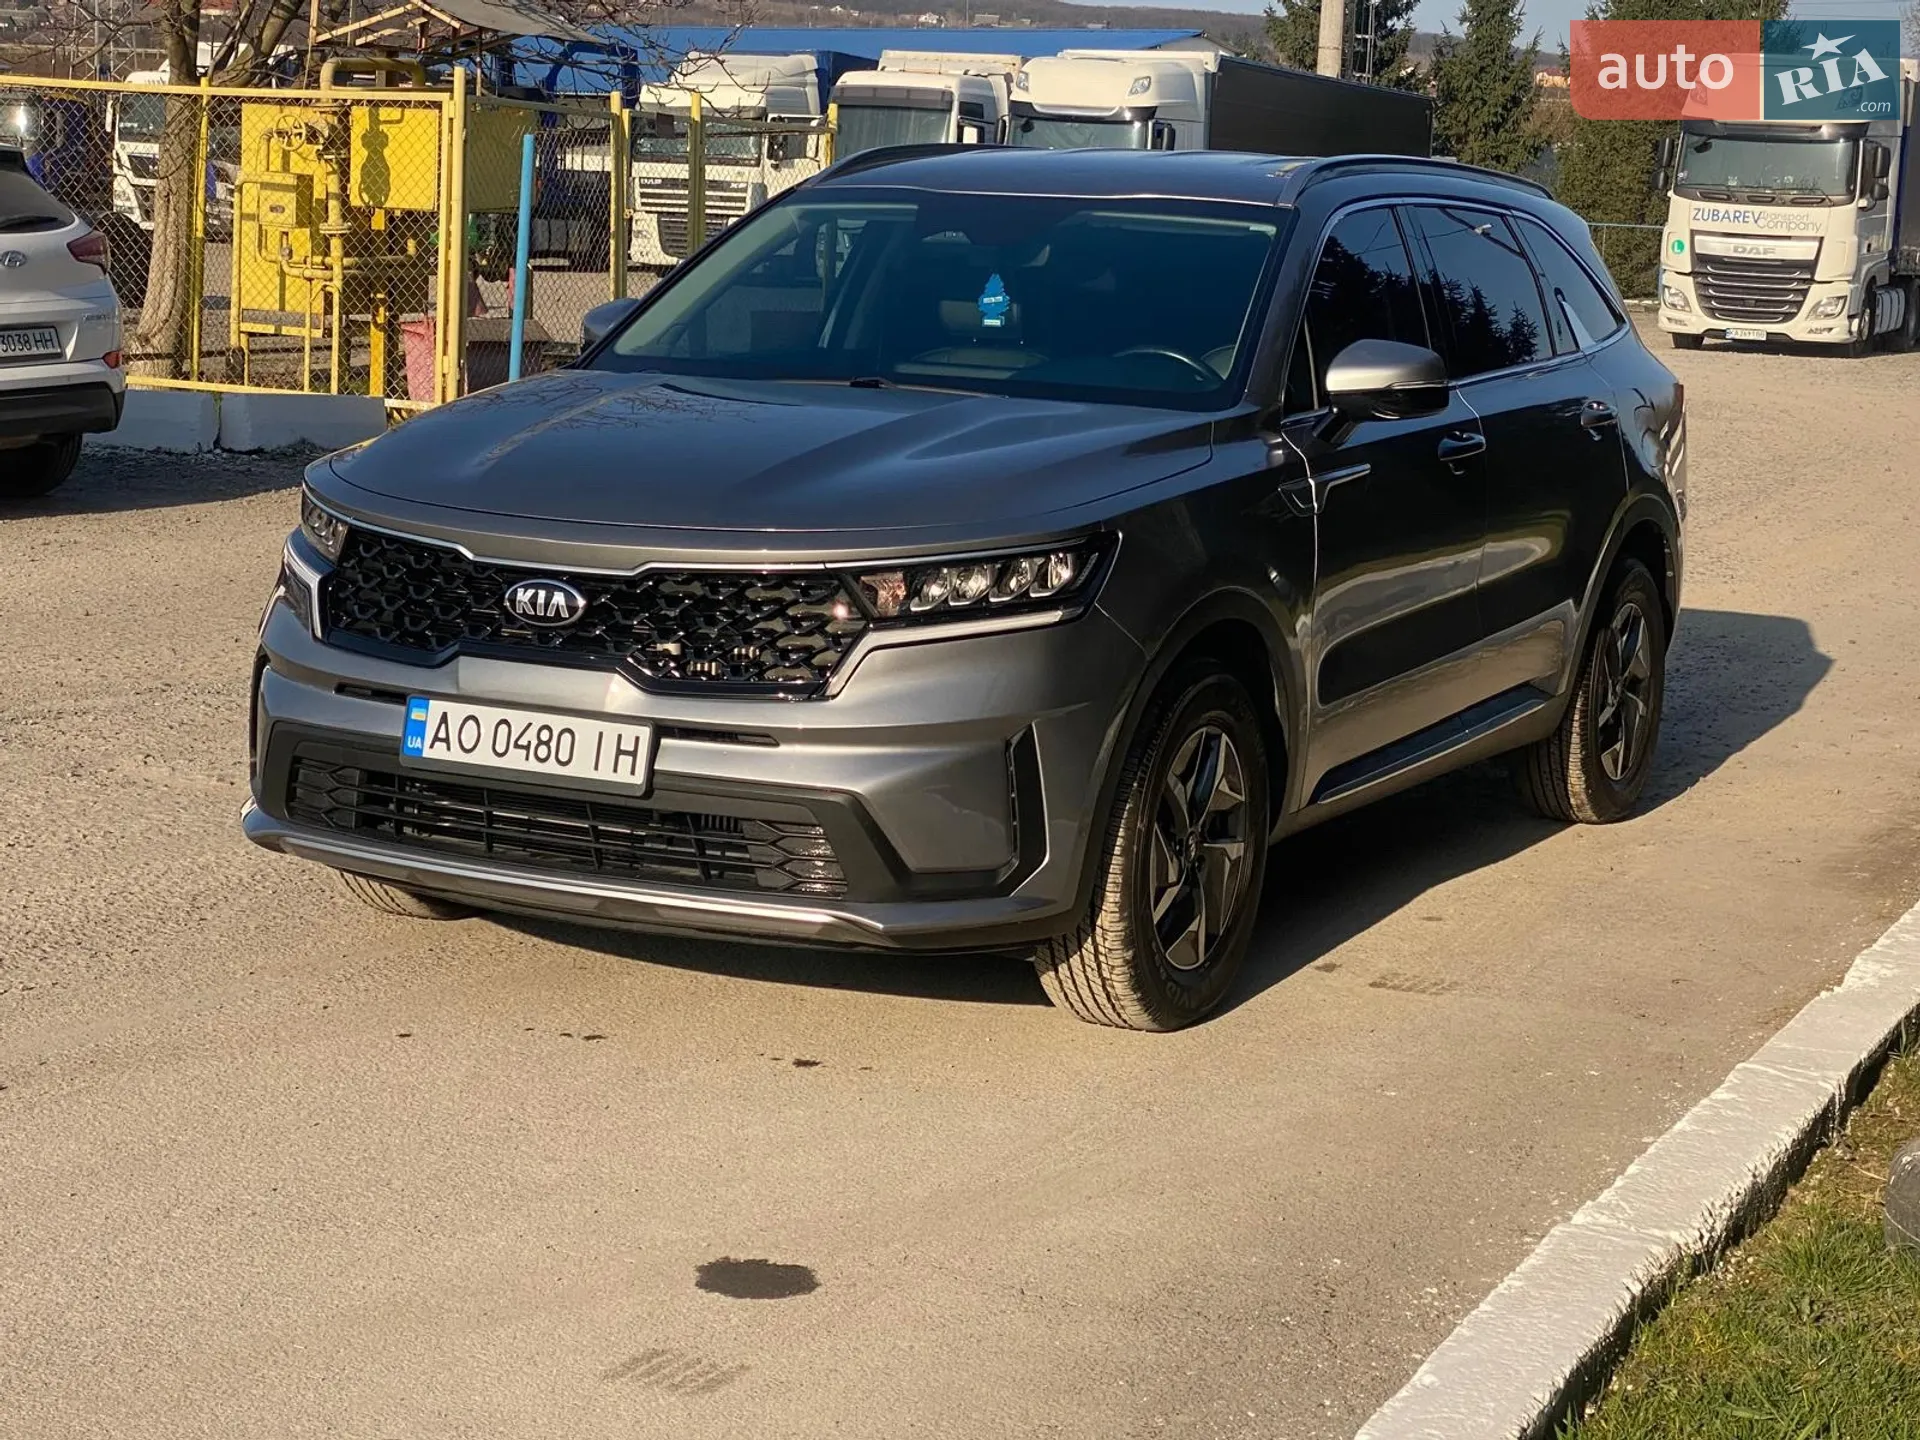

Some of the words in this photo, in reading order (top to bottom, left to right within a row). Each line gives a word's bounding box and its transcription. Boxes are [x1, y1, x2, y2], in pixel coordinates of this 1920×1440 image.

[1693, 207, 1762, 223] ZUBAREV
[1732, 244, 1777, 256] DAF
[0, 333, 32, 352] 3038
[33, 332, 55, 350] HH
[515, 587, 569, 618] KIA
[407, 735, 423, 749] UA
[429, 711, 482, 755] AO
[491, 718, 576, 767] 0480
[593, 731, 641, 777] IH
